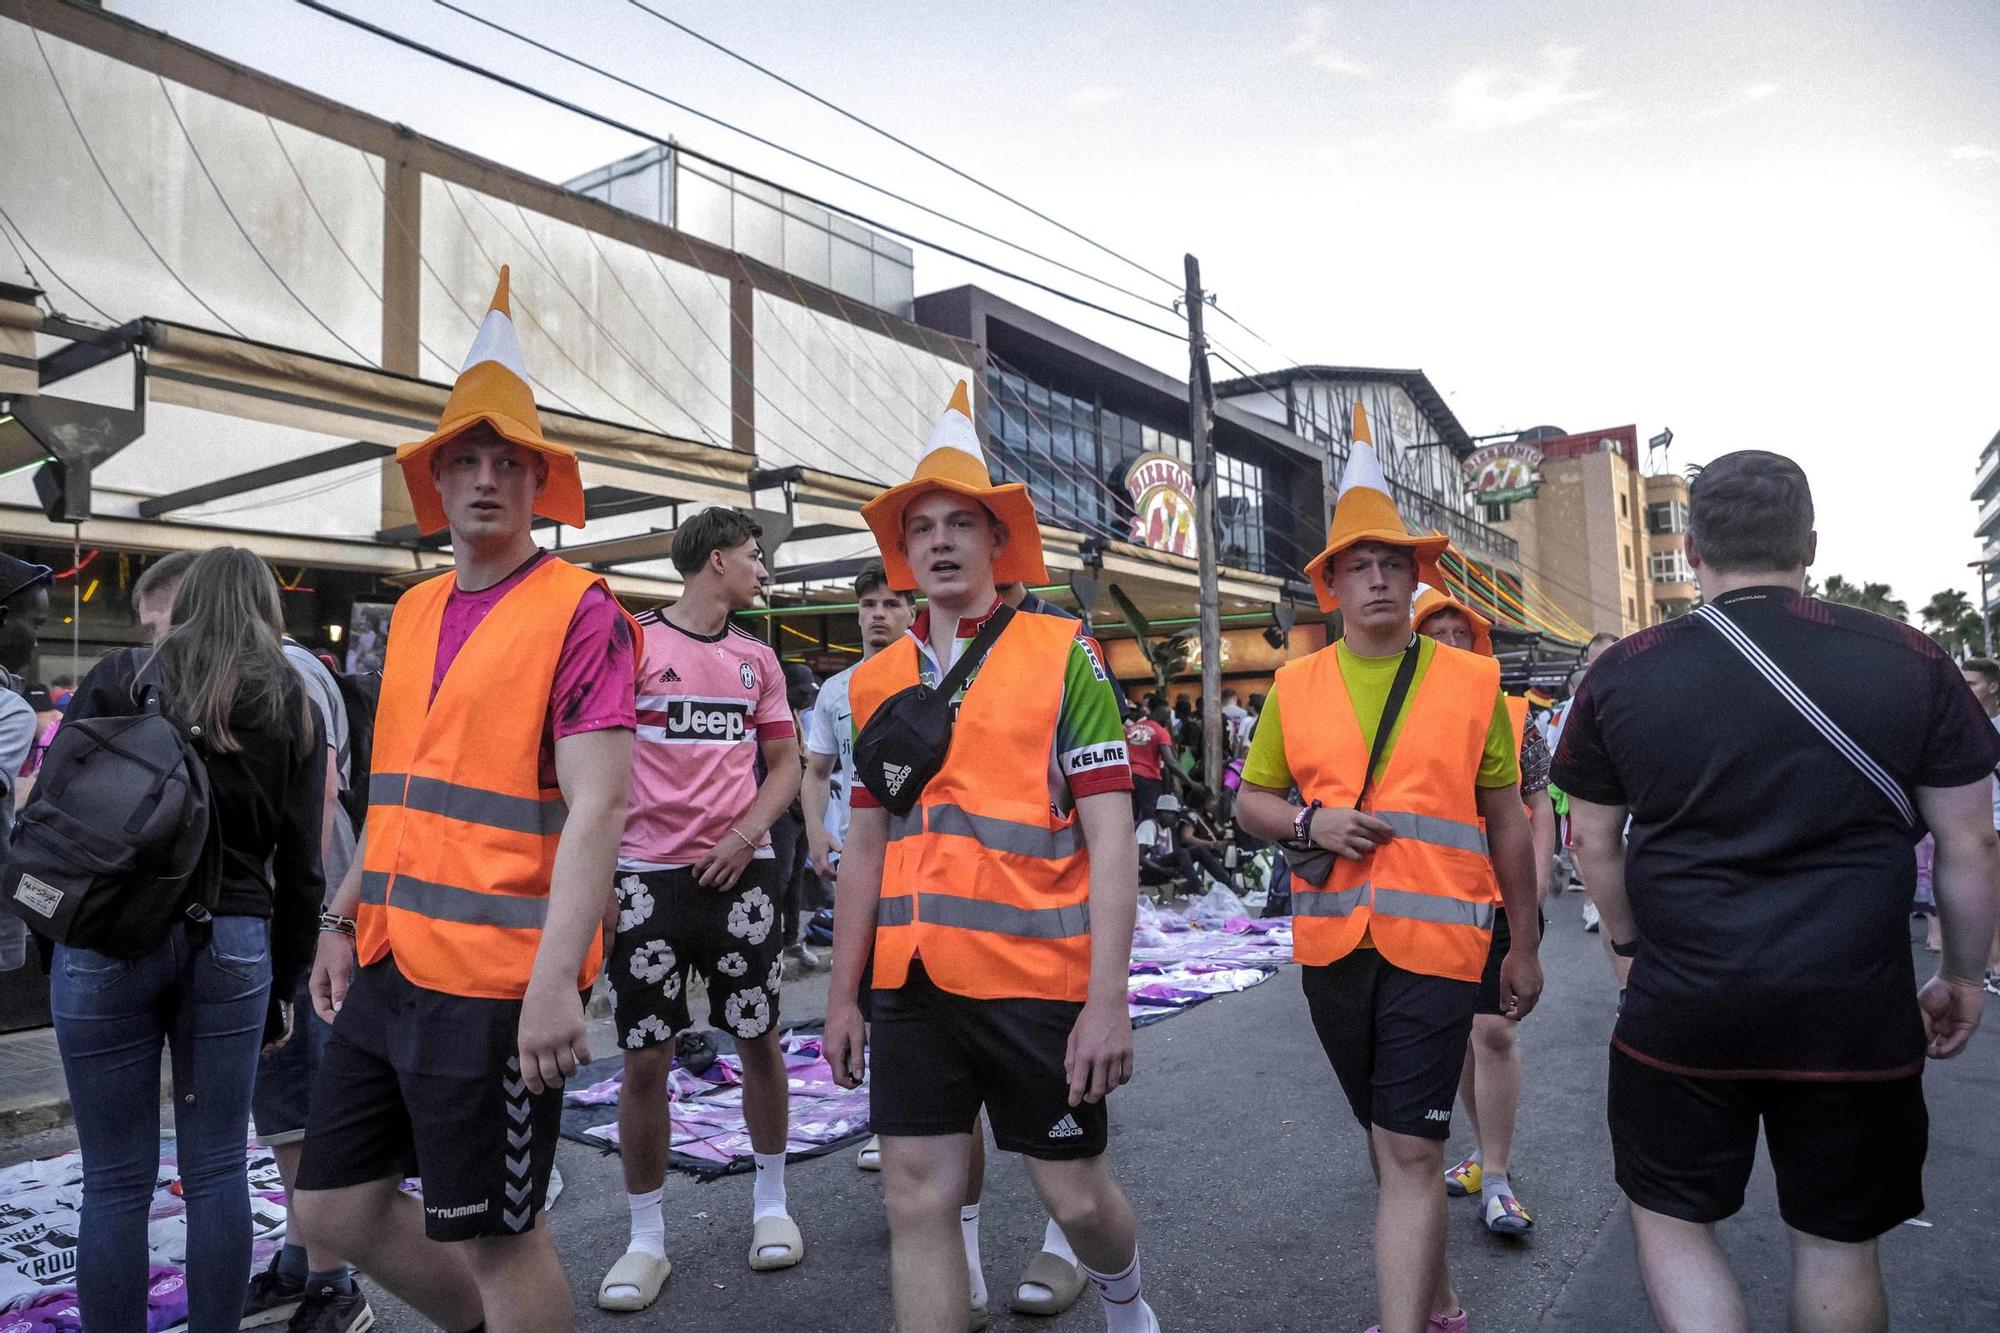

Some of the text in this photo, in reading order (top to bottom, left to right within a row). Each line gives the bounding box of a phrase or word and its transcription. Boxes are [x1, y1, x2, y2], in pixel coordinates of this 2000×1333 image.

[668, 702, 744, 740] Jeep
[1071, 747, 1124, 769] KELME
[890, 764, 912, 797] adidas
[1425, 1109, 1450, 1121] JAKO
[1048, 1127, 1083, 1138] adidas
[17, 1250, 75, 1278] KROO
